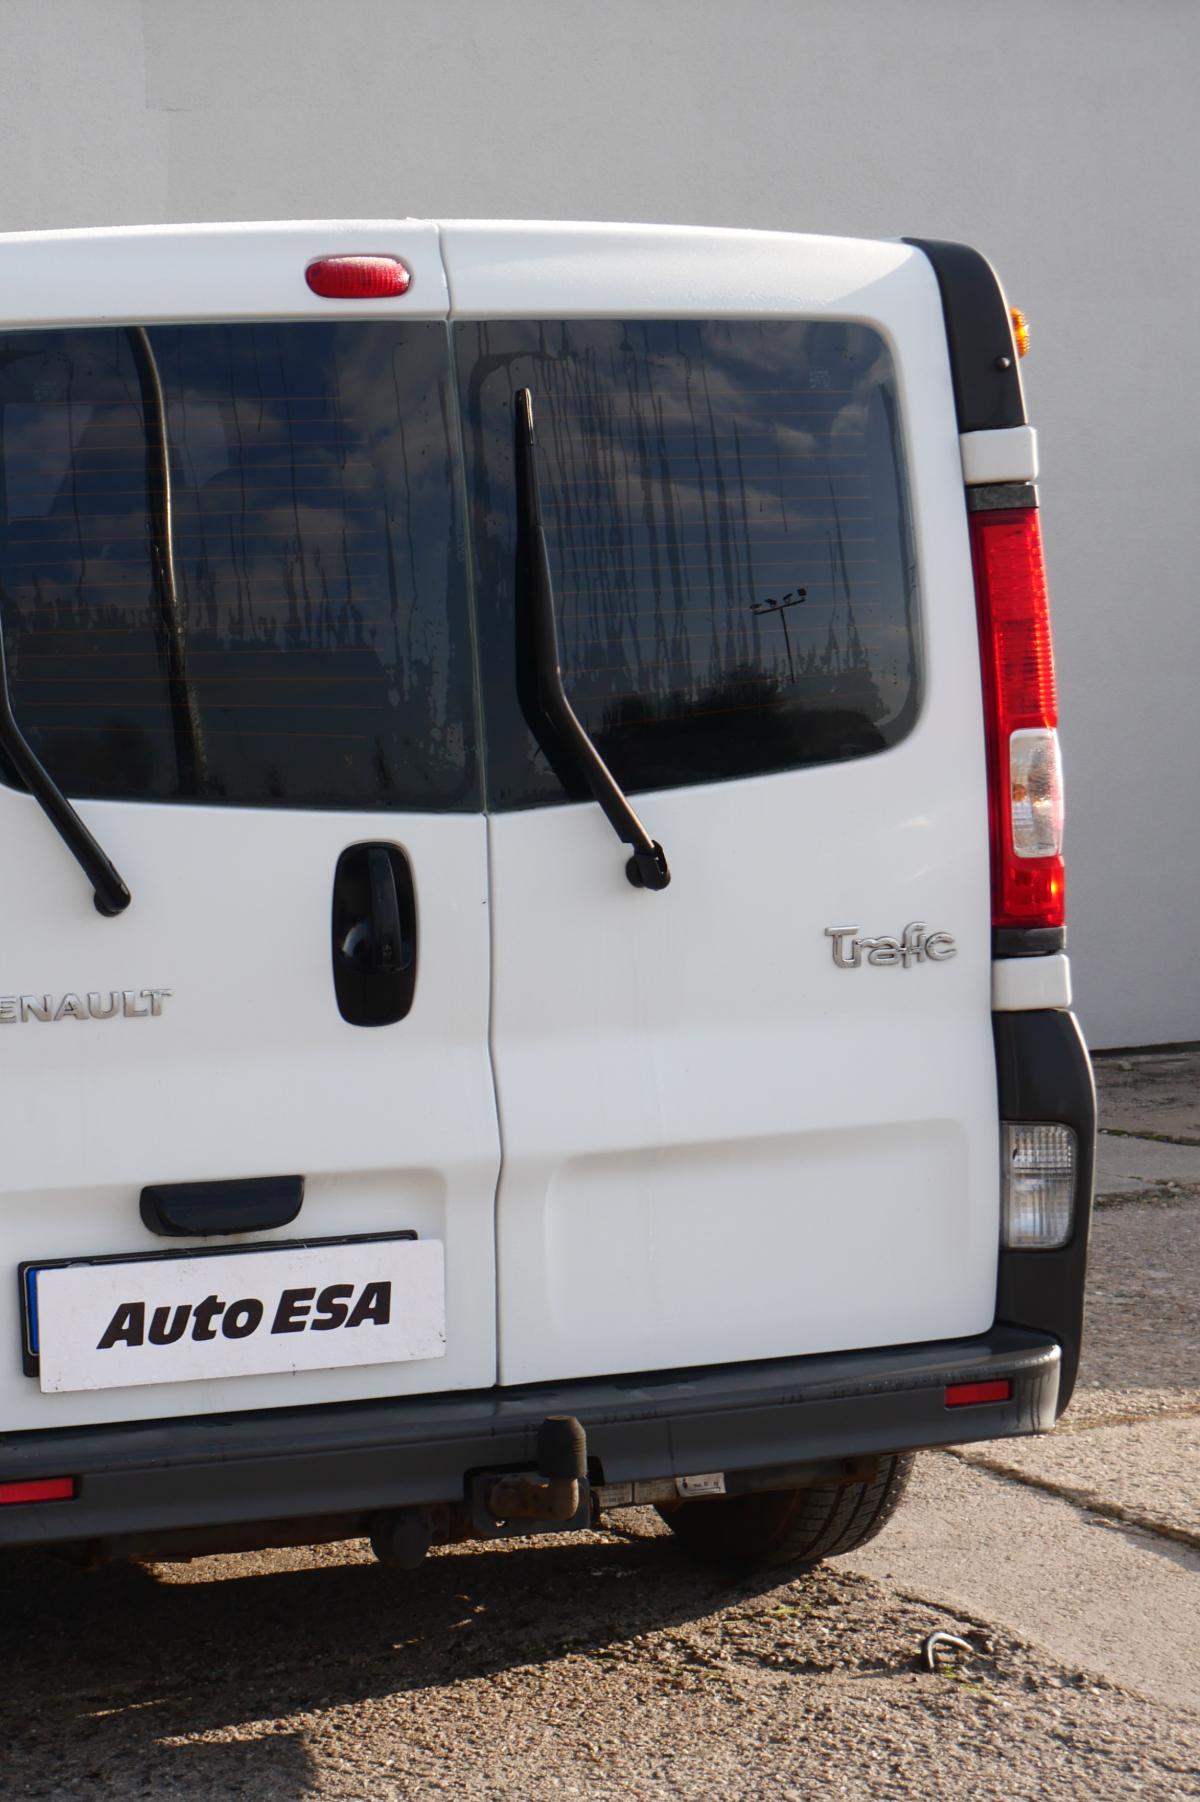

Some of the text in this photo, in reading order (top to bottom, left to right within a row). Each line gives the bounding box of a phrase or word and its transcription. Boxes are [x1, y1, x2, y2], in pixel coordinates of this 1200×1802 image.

[824, 921, 958, 969] Trafic
[96, 1281, 392, 1349] Auto ESA
